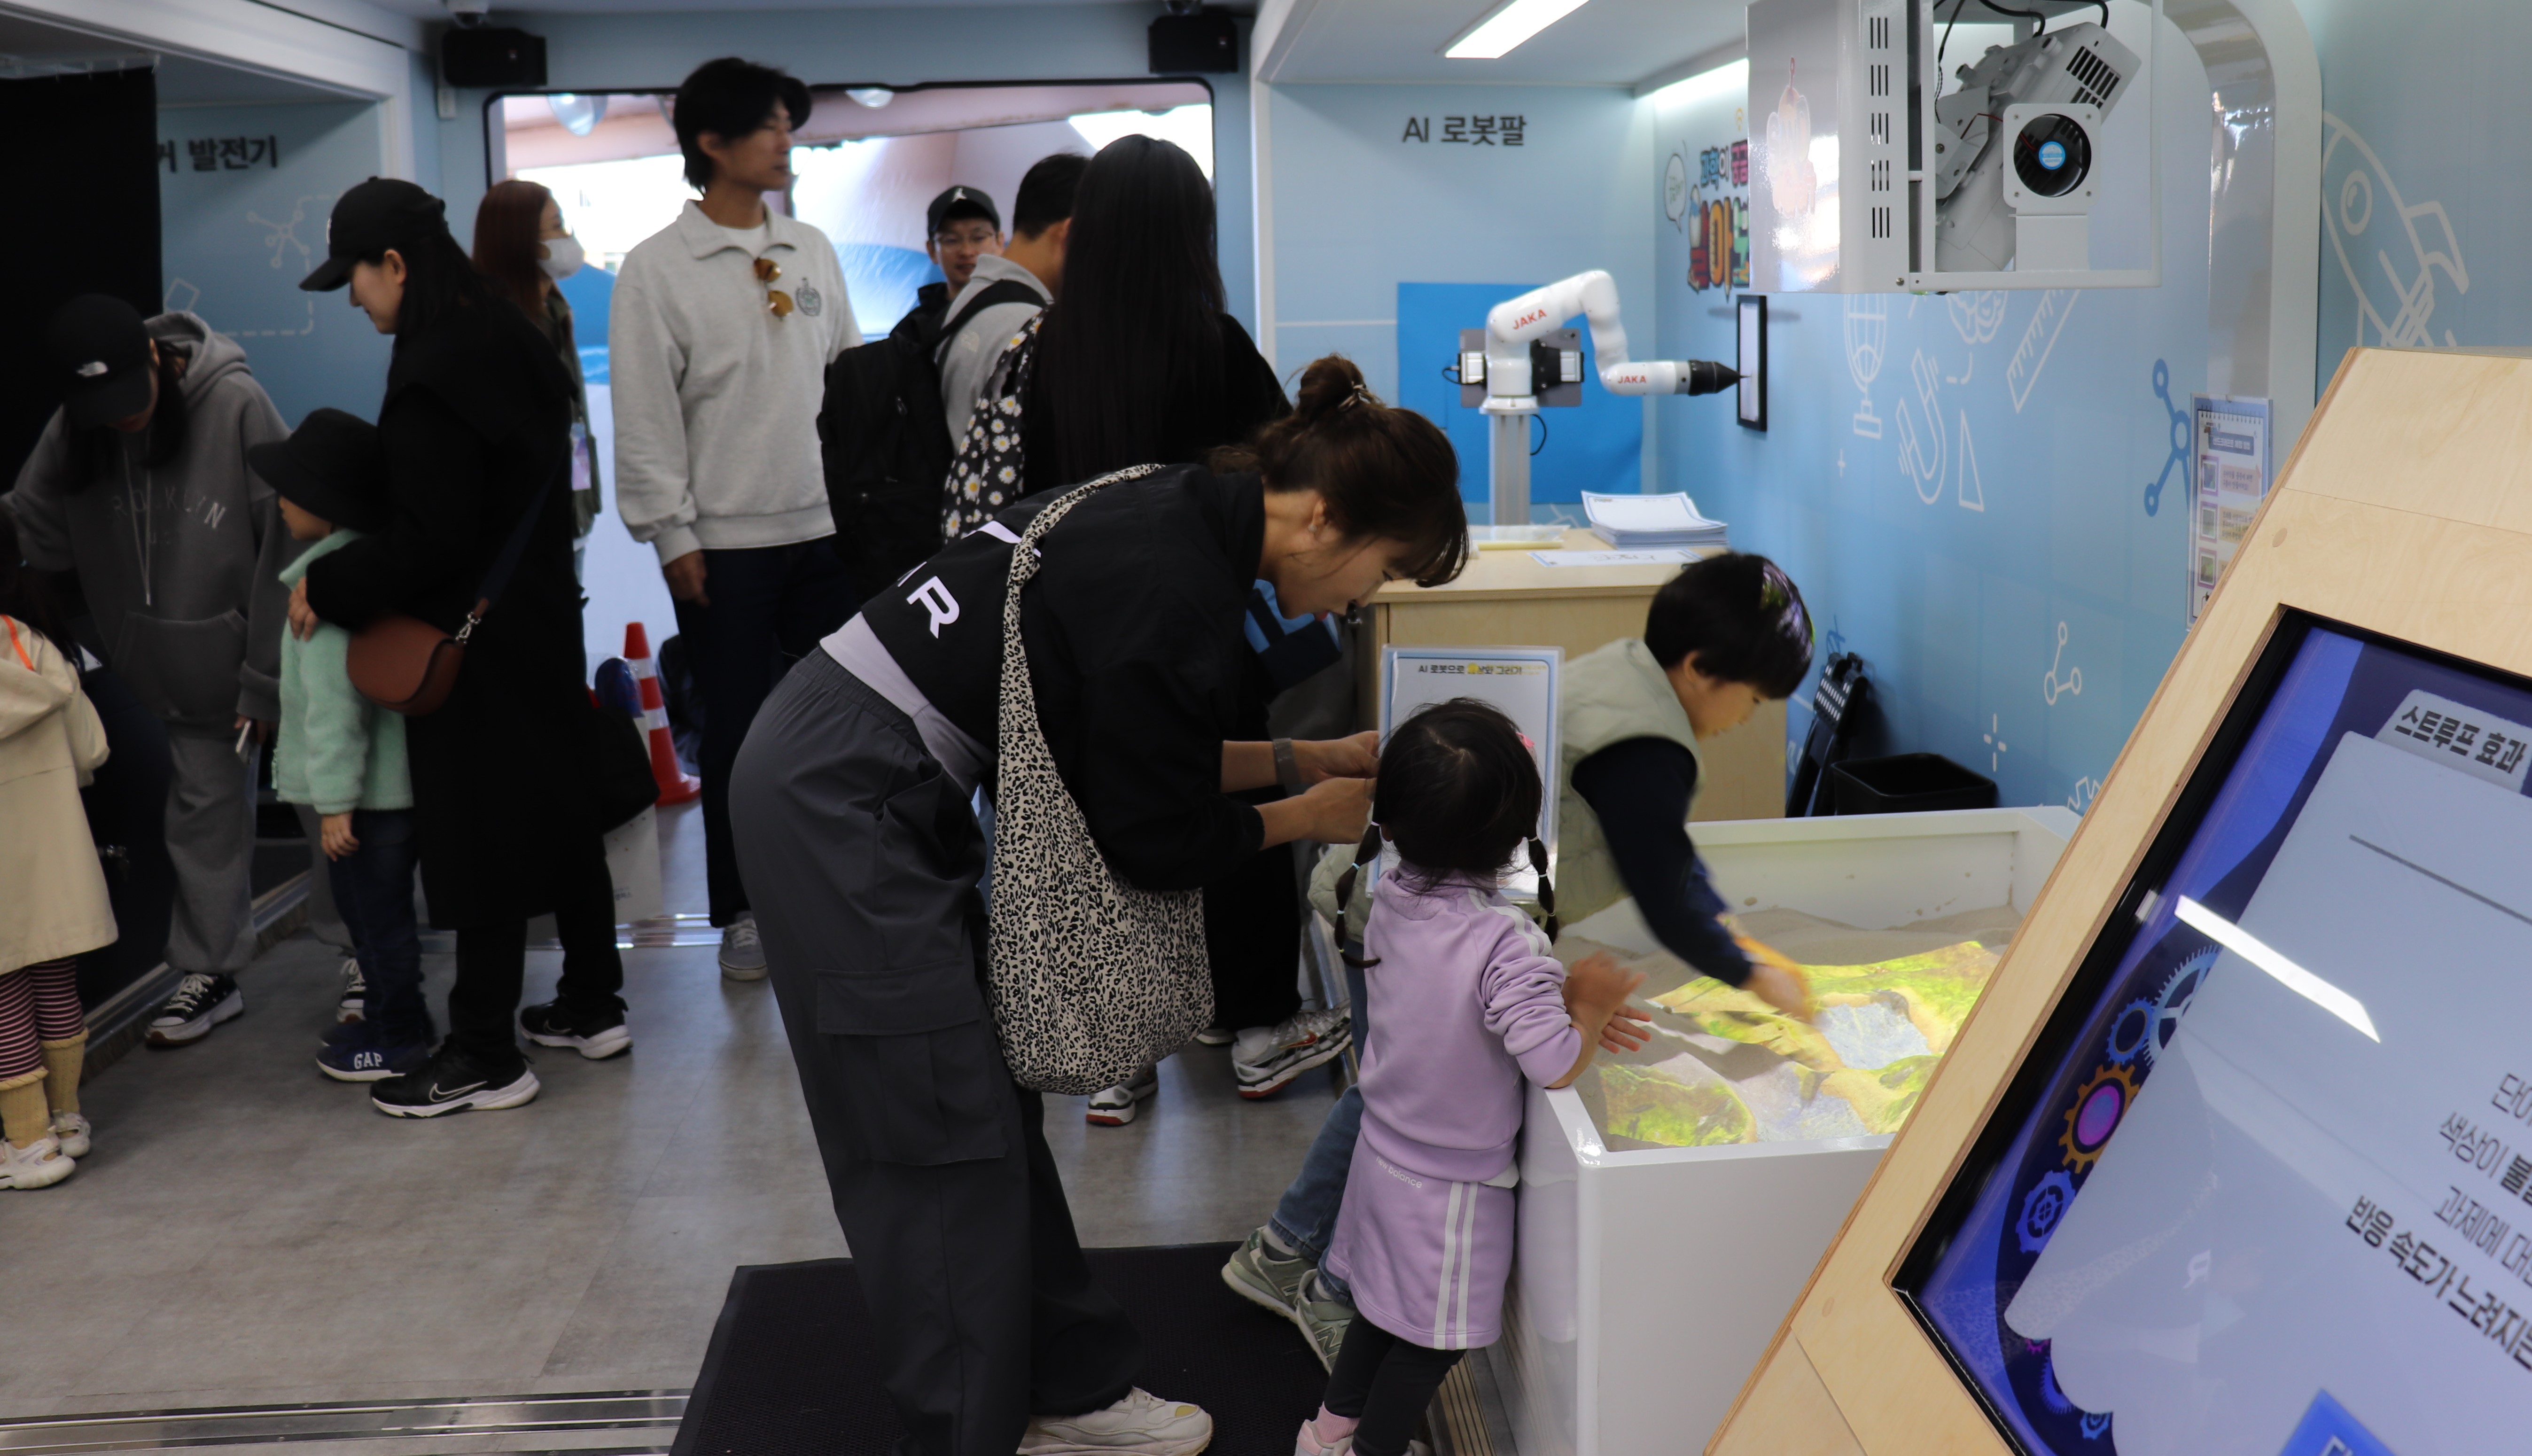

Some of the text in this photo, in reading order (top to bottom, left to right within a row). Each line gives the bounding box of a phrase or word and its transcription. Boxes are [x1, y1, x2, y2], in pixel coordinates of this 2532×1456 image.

[1402, 115, 1527, 146] AI 로봇팔
[188, 135, 278, 172] 발전기
[1699, 146, 1730, 191] 과학이
[1512, 308, 1547, 330] JAKA
[1617, 375, 1647, 384] JAKA
[1430, 664, 1465, 674] 로봇으로
[2394, 705, 2528, 774] 스트루프 효과
[354, 1051, 383, 1070] GAP
[2439, 1111, 2510, 1179] 색상이
[1376, 1156, 1422, 1188] new balance
[2345, 1195, 2394, 1249] 반응
[2389, 1230, 2458, 1300] 속도가
[2433, 1185, 2532, 1288] 과제에 대
